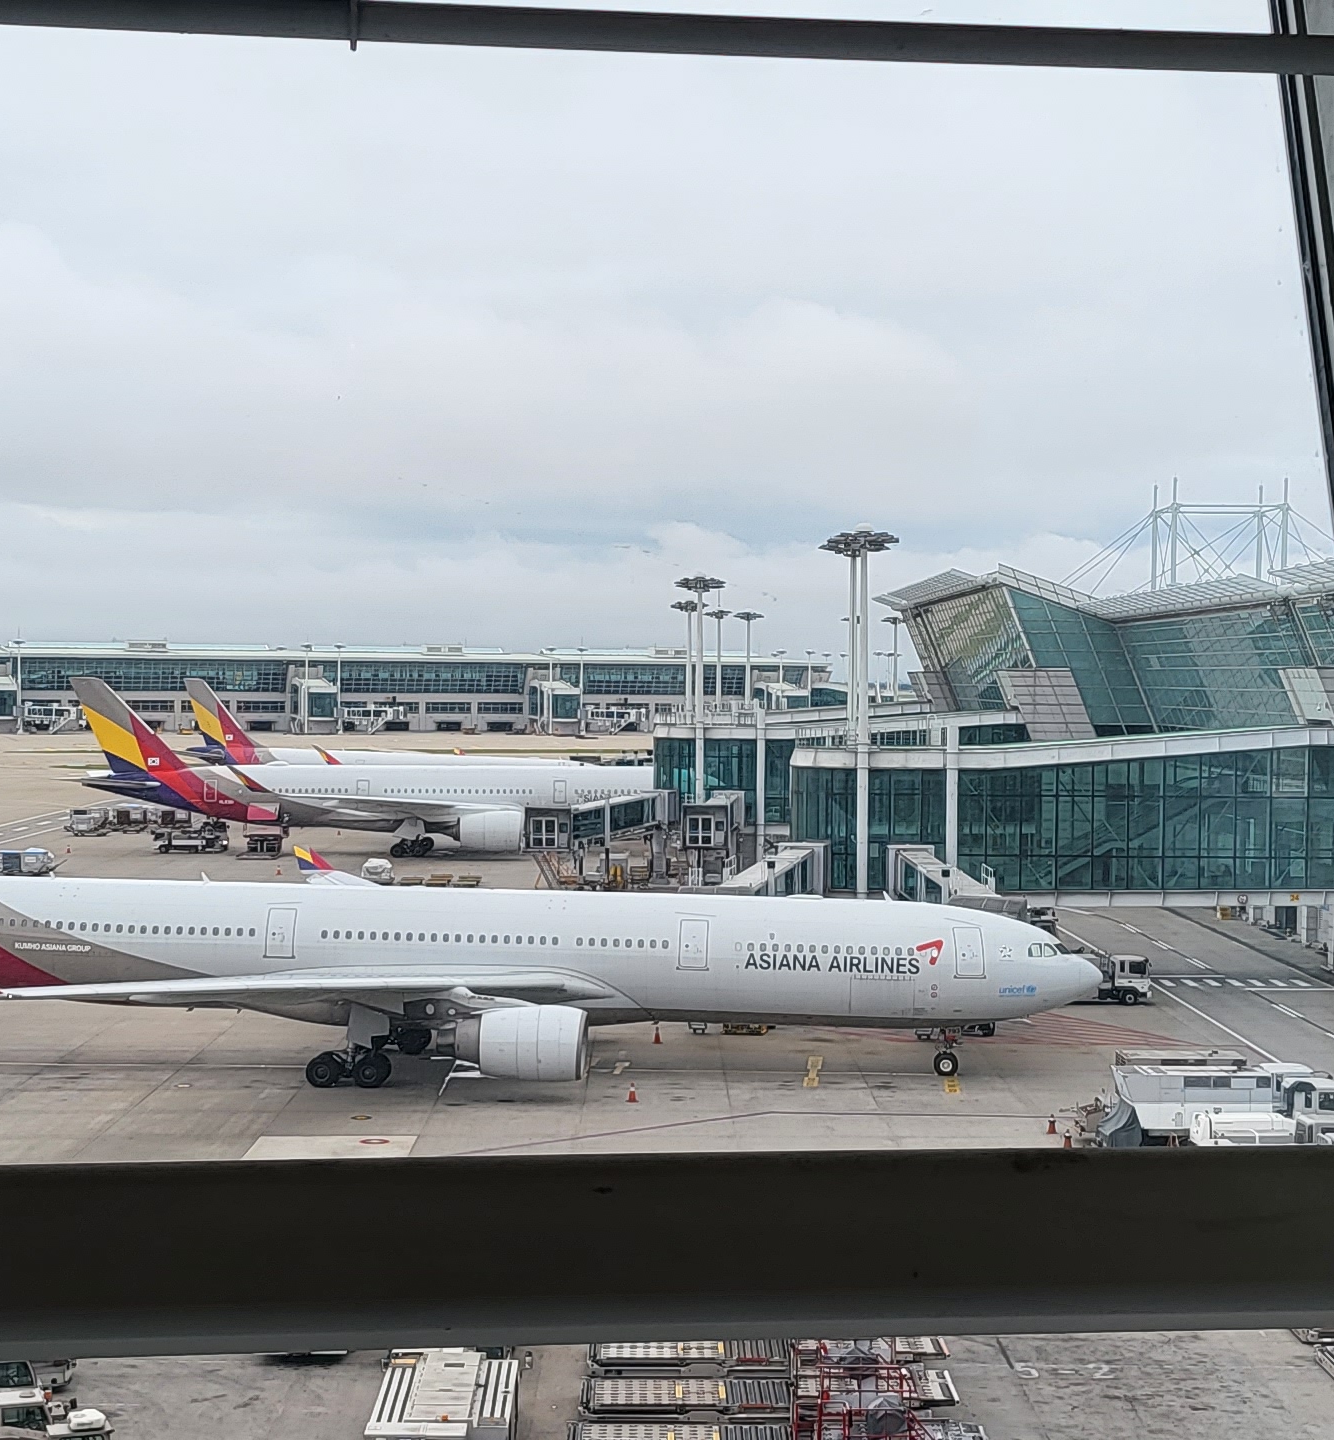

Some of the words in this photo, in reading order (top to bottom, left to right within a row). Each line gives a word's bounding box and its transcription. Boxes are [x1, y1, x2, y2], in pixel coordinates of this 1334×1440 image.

[14, 942, 40, 950] KUMHO
[41, 943, 66, 951] ASIANA
[67, 944, 91, 952] GROUP
[744, 953, 821, 972] ASIANA
[828, 955, 920, 974] AIRLINES
[998, 985, 1026, 994] unicef
